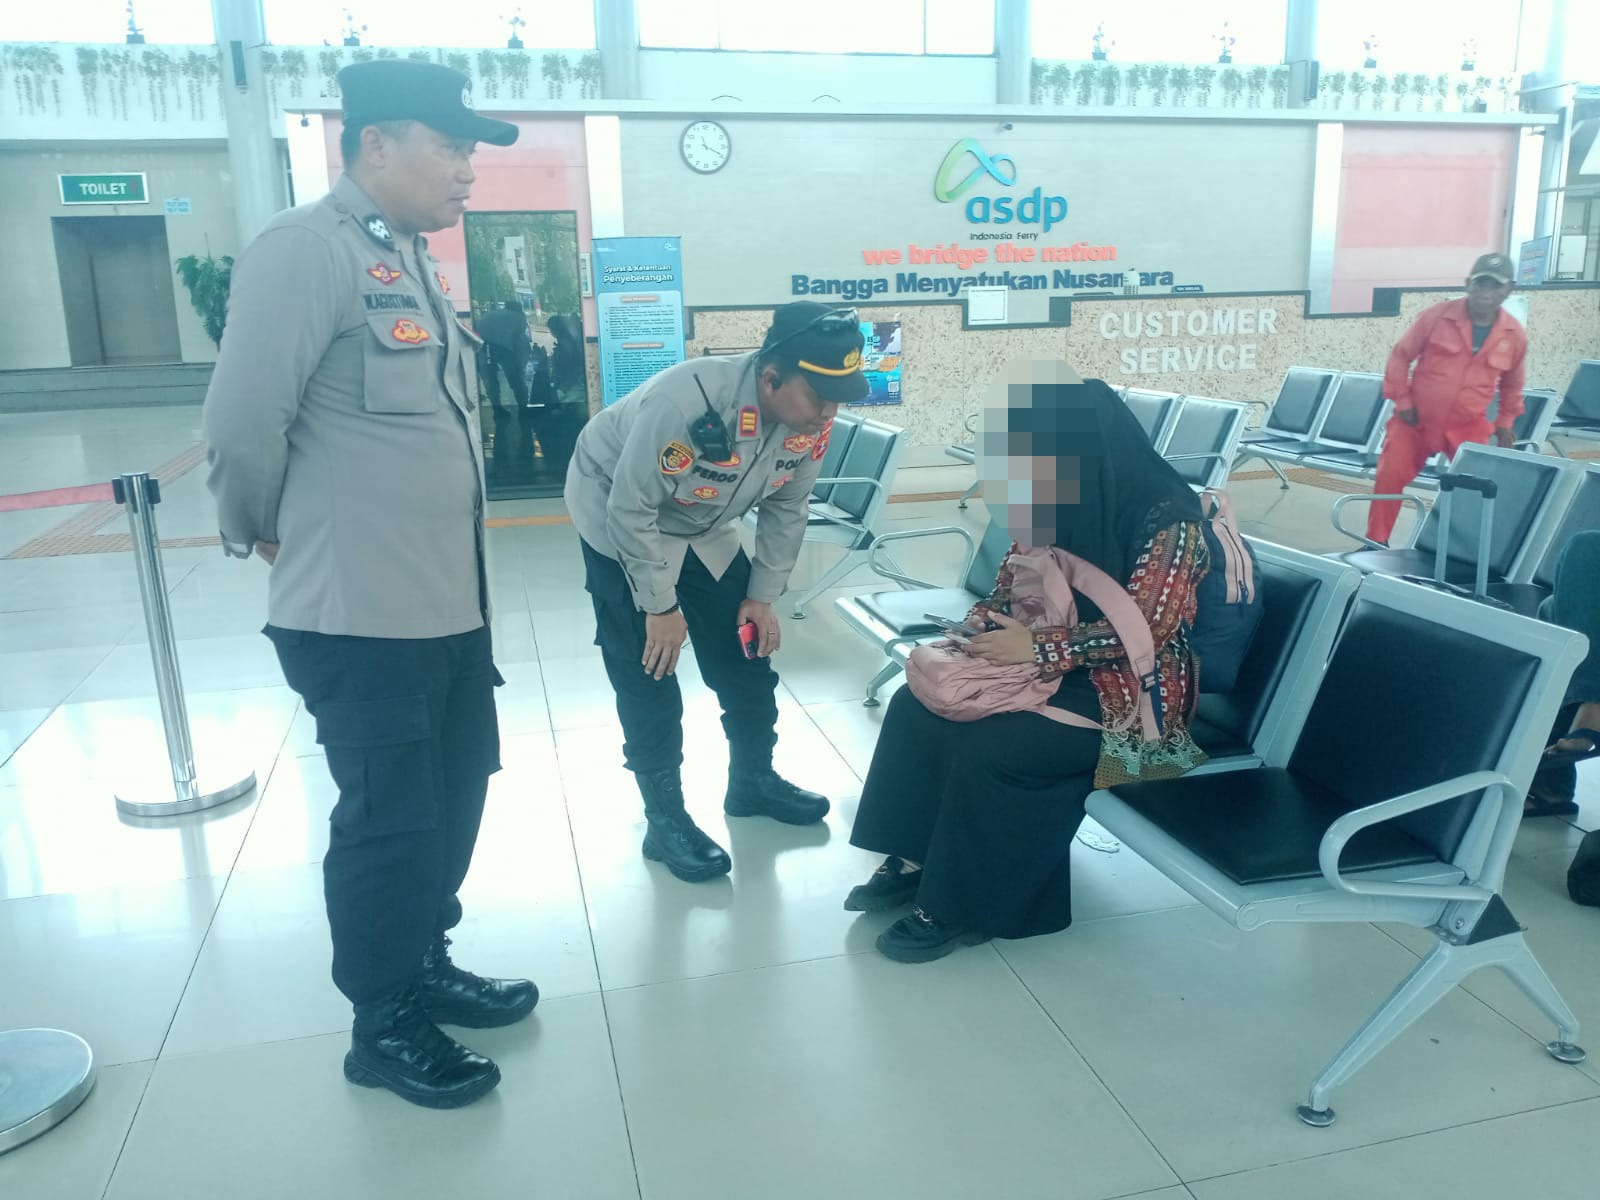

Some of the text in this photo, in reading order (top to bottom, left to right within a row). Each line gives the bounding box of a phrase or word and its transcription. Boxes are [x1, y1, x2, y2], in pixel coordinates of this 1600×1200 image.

[79, 183, 126, 195] TOILET
[966, 187, 1067, 233] asdp
[970, 231, 1038, 241] Indonesia Ferry
[863, 242, 1117, 270] we bridge the nation
[603, 274, 673, 284] Penyeberangan
[792, 275, 888, 300] Bangga
[1053, 269, 1174, 289] Nusanara
[1100, 308, 1277, 339] CUSTOMER
[1119, 343, 1256, 374] SERVICE
